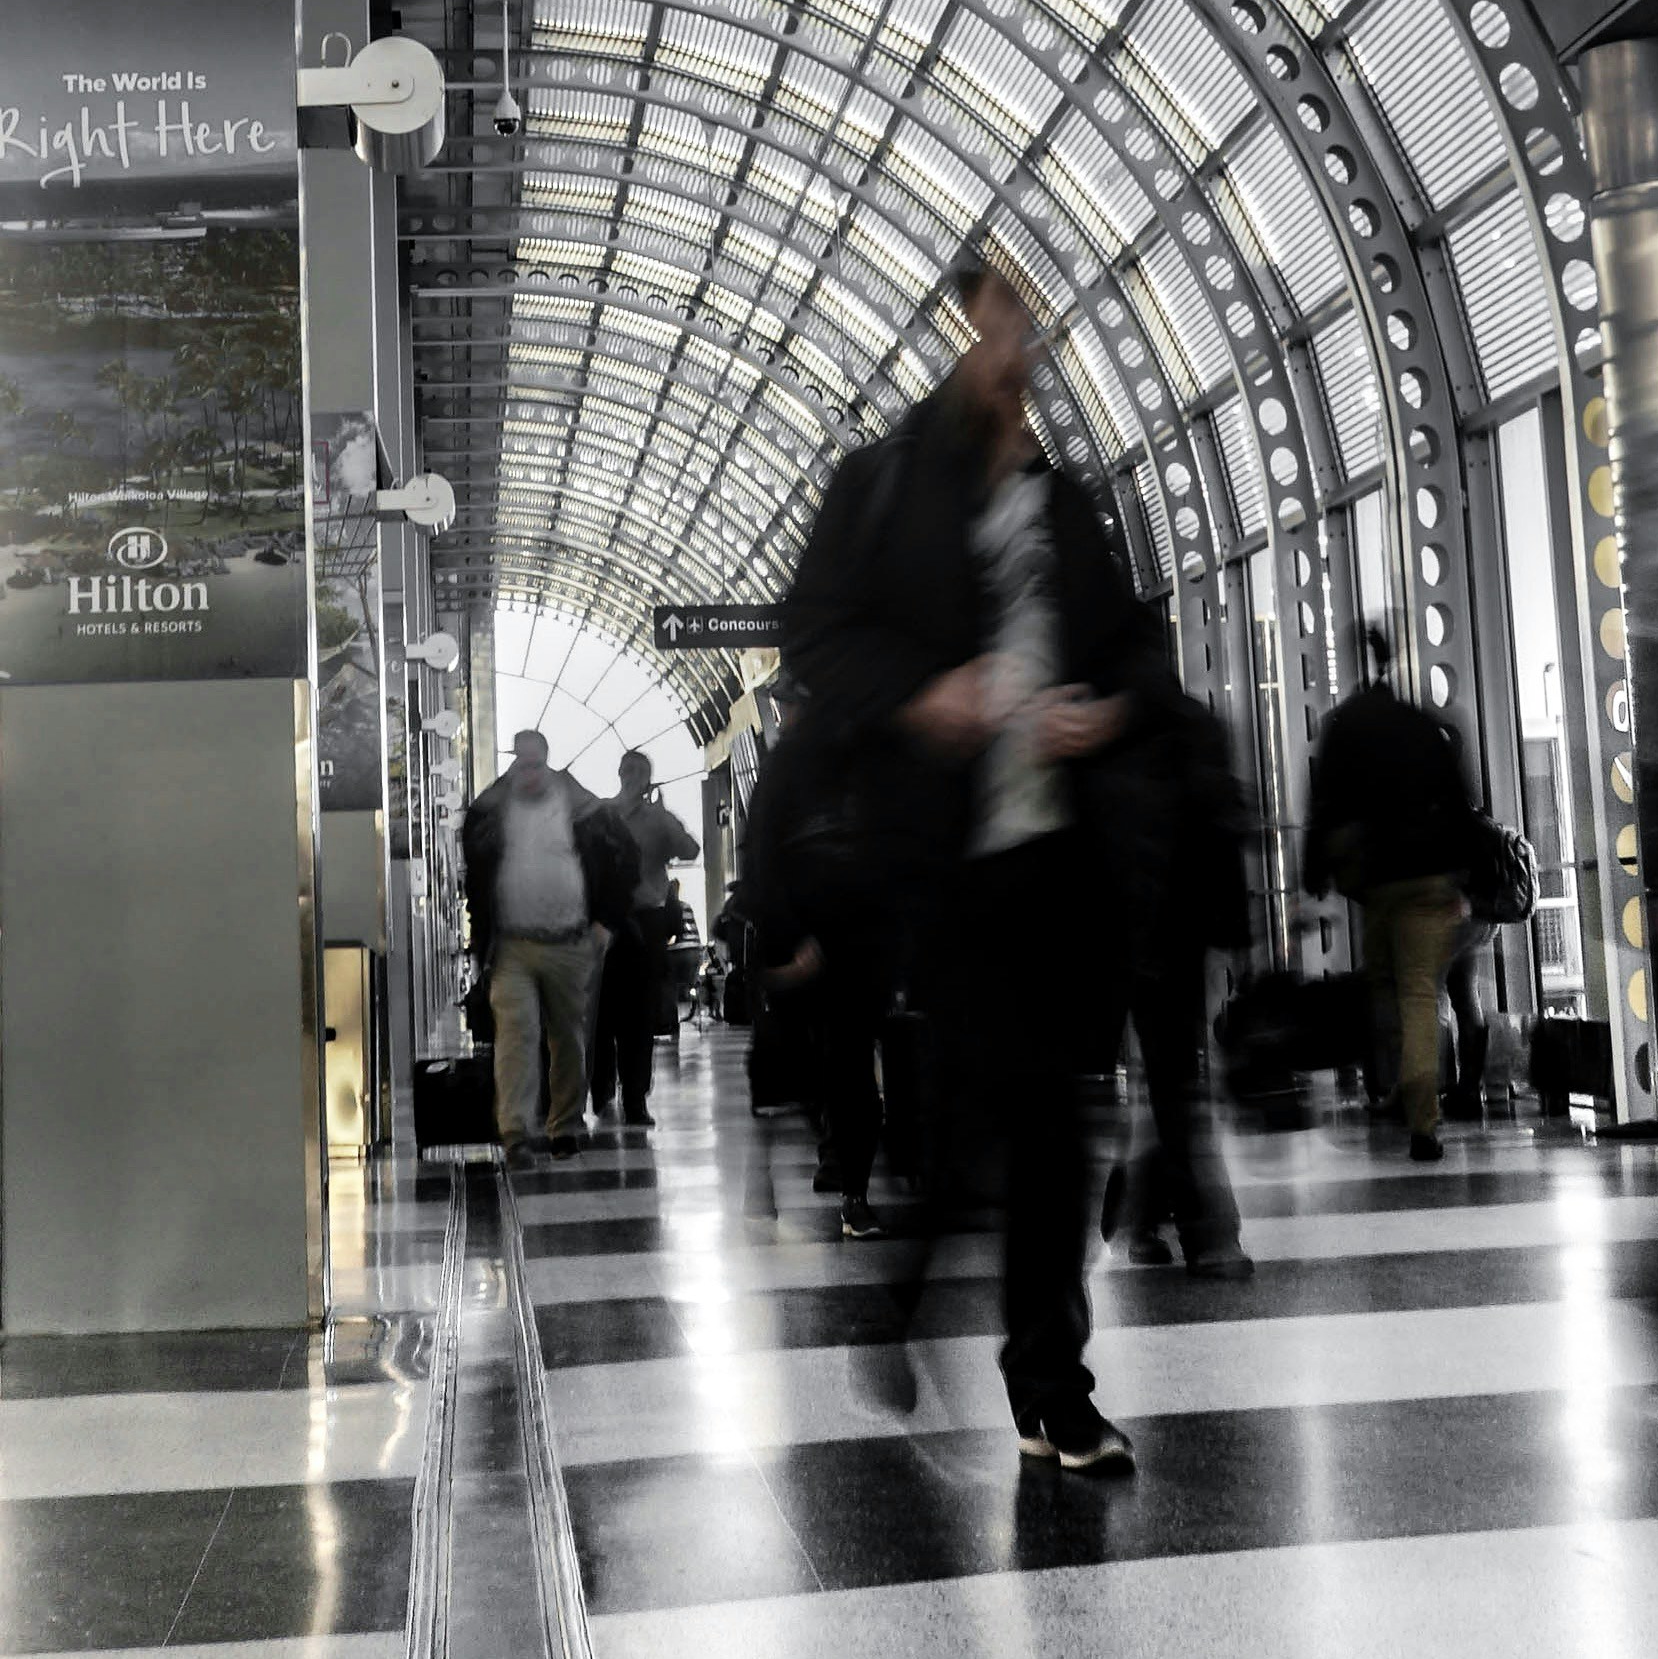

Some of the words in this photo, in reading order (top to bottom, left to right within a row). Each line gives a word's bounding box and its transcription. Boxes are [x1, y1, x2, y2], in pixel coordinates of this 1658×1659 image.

[63, 73, 105, 92] The
[112, 72, 181, 92] World
[188, 71, 207, 90] Is
[0, 99, 139, 189] Right
[155, 99, 275, 156] Here
[167, 489, 208, 502] Village
[68, 574, 209, 614] Hilton
[77, 622, 126, 636] HOTELS
[131, 622, 140, 633] &
[144, 620, 202, 634] RESORTS
[708, 617, 783, 632] Concours
